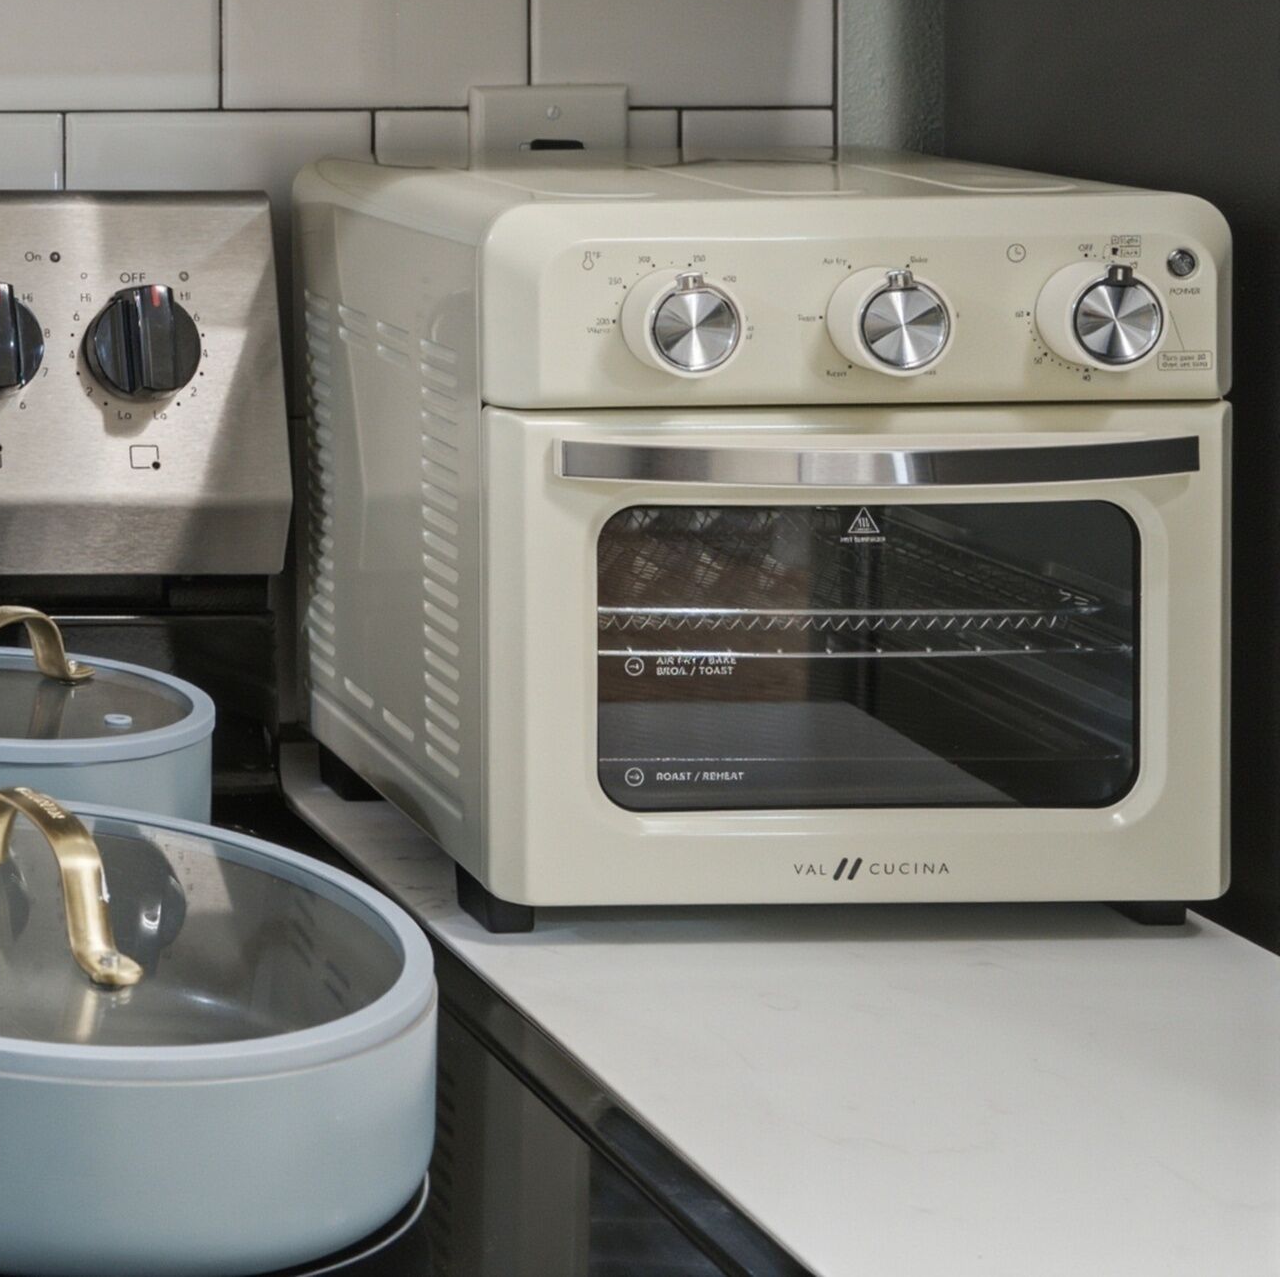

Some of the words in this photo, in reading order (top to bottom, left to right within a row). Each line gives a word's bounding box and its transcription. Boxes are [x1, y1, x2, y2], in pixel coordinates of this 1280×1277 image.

[24, 252, 42, 262] On
[119, 272, 146, 284] OFF
[80, 293, 92, 303] Hi
[73, 312, 80, 322] 6
[193, 312, 201, 322] 6
[68, 349, 75, 359] 4
[202, 349, 209, 359] 4
[85, 387, 93, 397] 2
[190, 387, 197, 397] 2
[19, 401, 26, 411] 6
[117, 410, 132, 420] Lo
[153, 410, 167, 420] Lo
[699, 666, 734, 675] TOAST
[656, 771, 691, 781] ROAST
[702, 772, 744, 781] REHEAT
[794, 864, 827, 875] VAL
[869, 862, 950, 875] CUCINA
